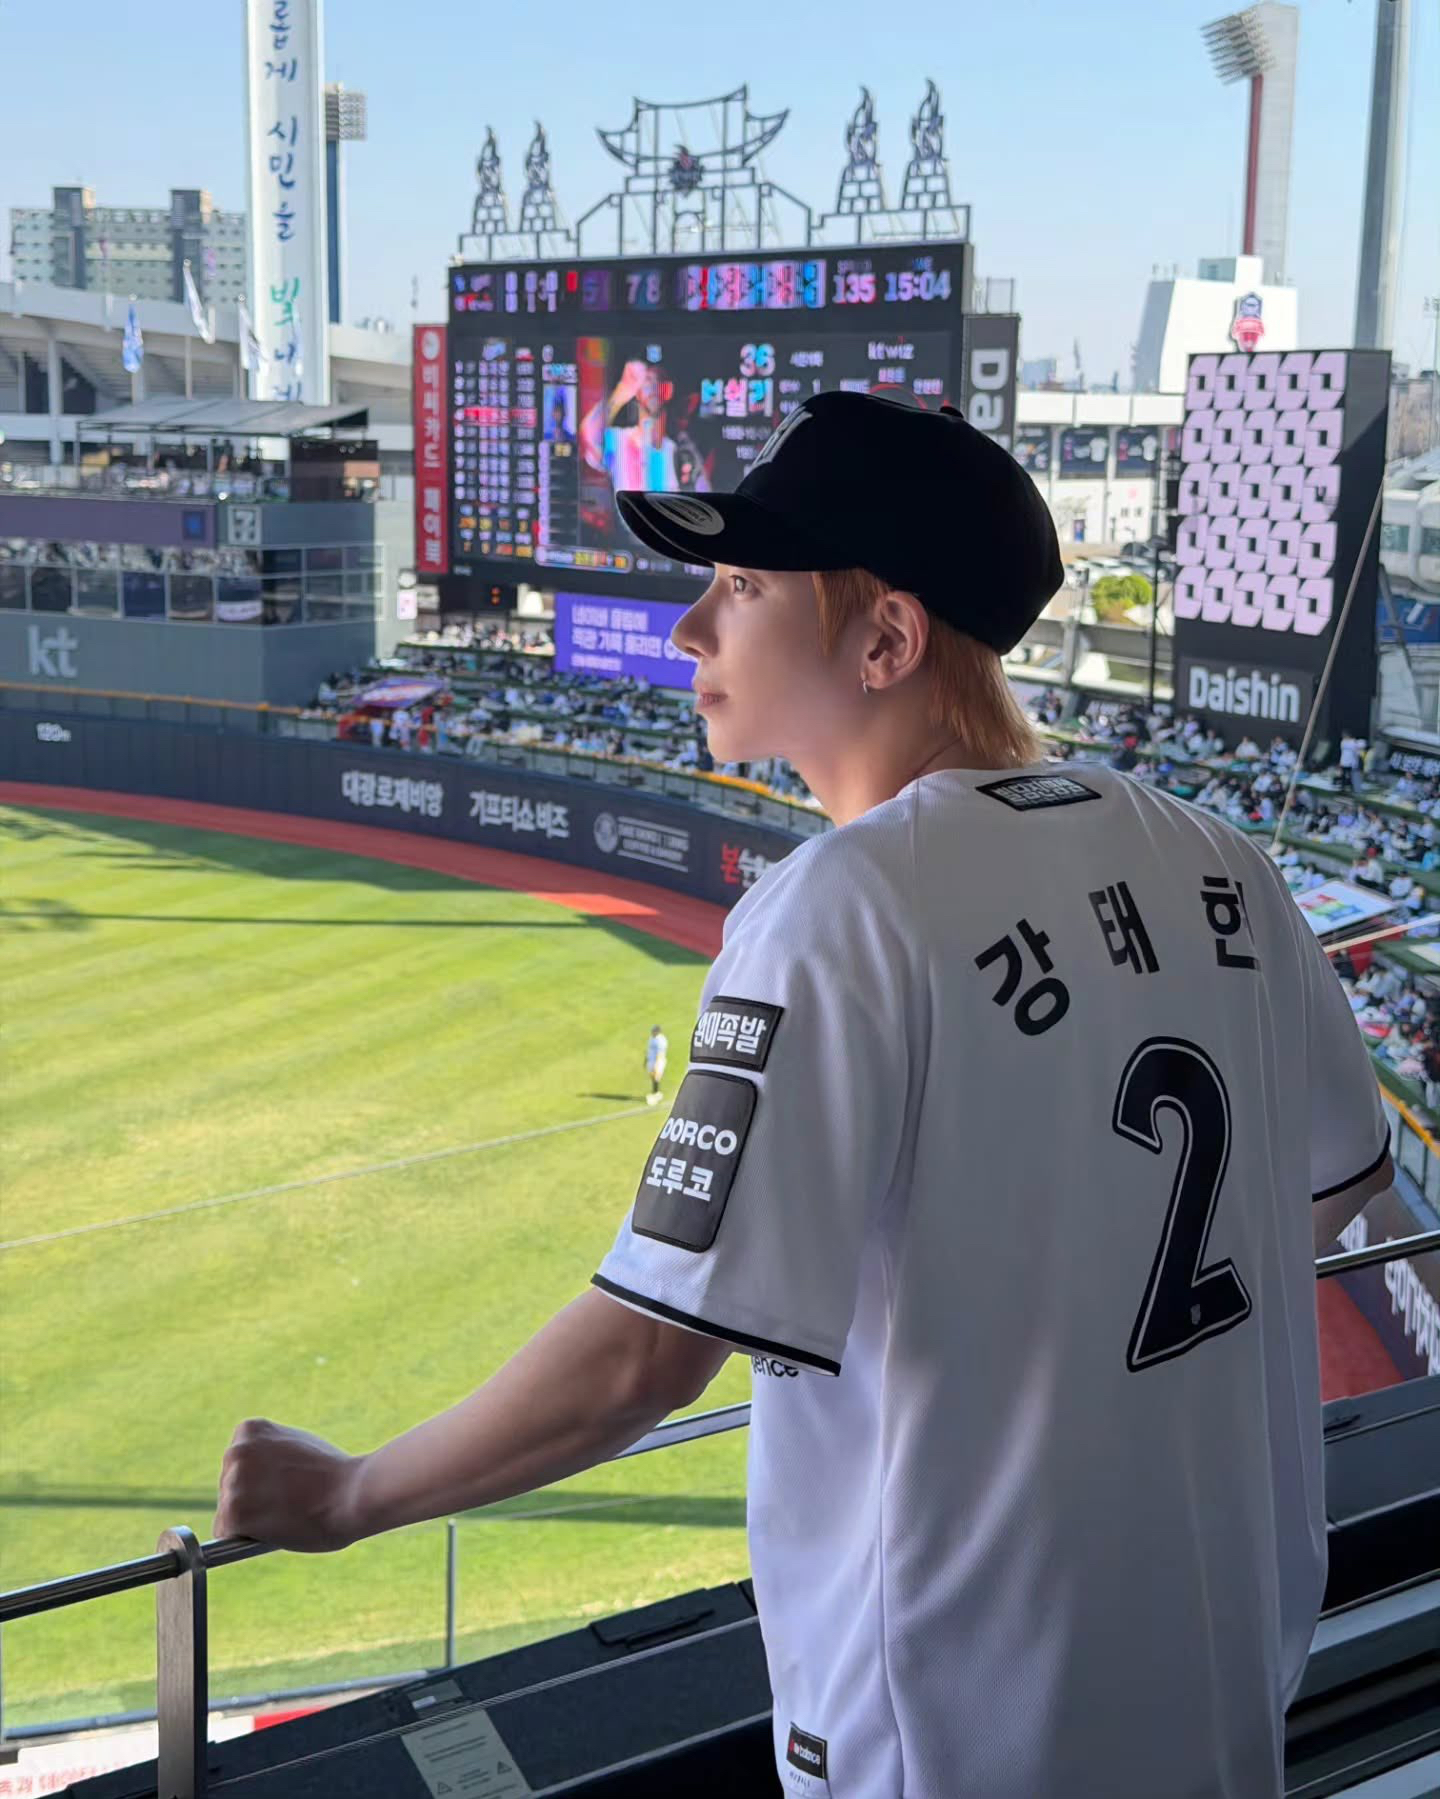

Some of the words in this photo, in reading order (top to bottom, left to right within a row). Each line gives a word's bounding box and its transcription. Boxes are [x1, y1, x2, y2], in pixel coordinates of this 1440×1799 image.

[267, 115, 299, 241] 시민을
[832, 272, 877, 304] 135
[884, 270, 951, 302] 15:04
[740, 343, 776, 377] 36
[27, 623, 78, 679] kt
[1189, 665, 1300, 723] Daishin
[341, 770, 444, 818] 대광로제비앙
[659, 1117, 738, 1156] DORCO
[645, 1155, 714, 1202] 도루코
[1112, 1035, 1252, 1373] 2
[752, 1355, 800, 1378] ence
